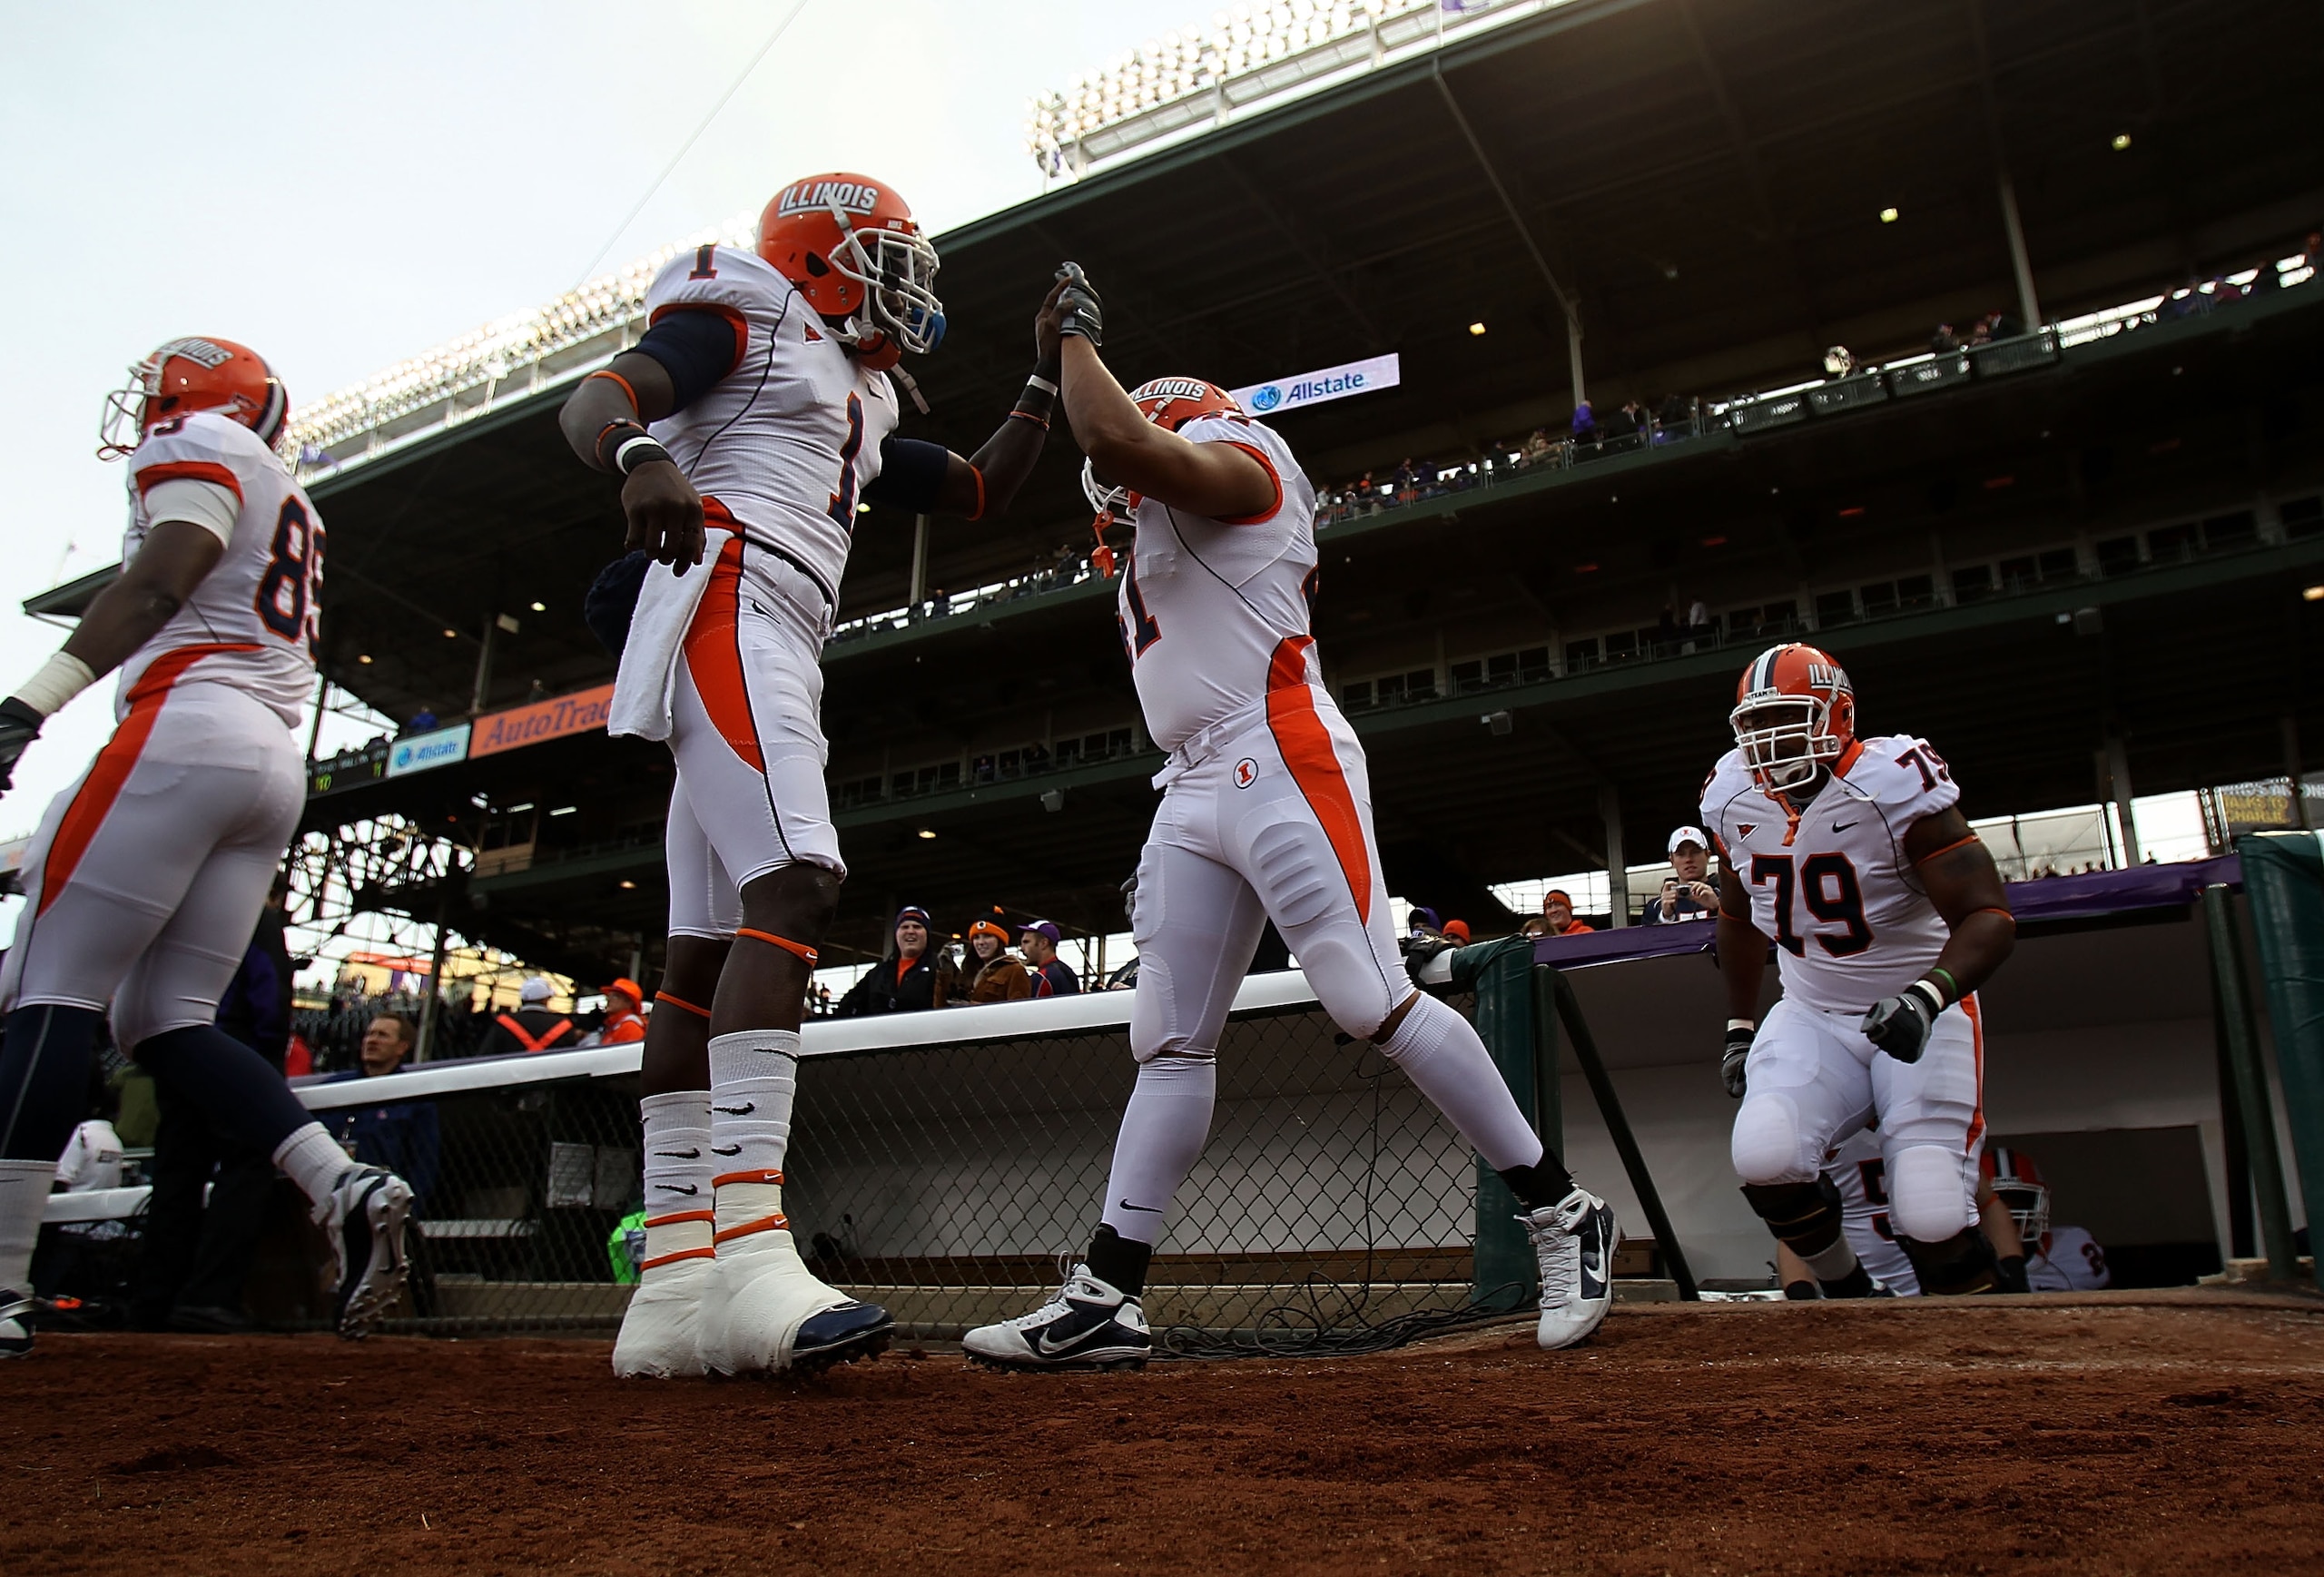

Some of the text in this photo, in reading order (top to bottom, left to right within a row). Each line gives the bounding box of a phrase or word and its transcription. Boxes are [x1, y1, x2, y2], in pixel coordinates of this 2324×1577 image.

[778, 182, 878, 212] ILLINOIS
[1285, 373, 1364, 403] Allstate
[254, 495, 327, 662] 8
[418, 741, 458, 761] Allstate
[1751, 852, 1875, 958] 79
